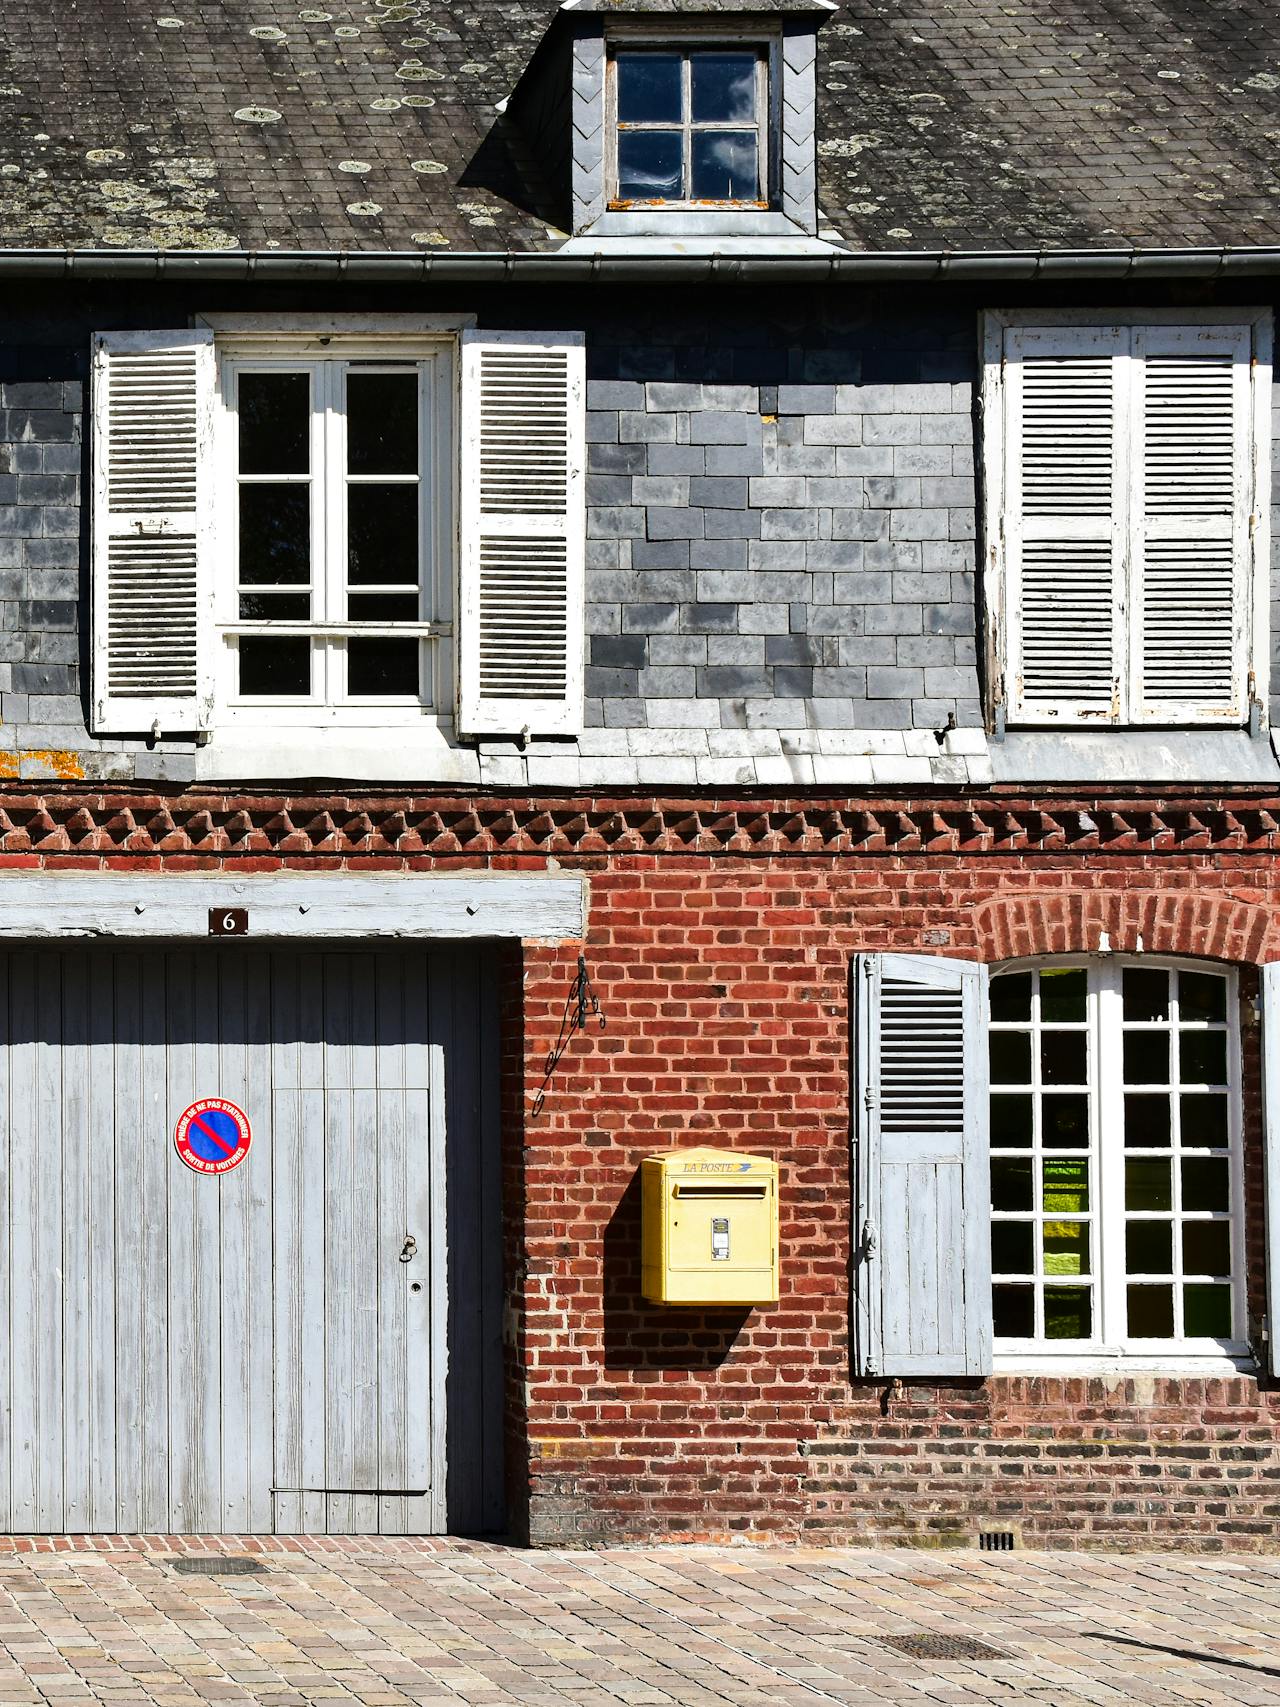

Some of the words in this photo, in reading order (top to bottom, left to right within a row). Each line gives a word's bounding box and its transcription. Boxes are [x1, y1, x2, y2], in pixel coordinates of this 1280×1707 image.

[223, 912, 236, 930] 6
[178, 1116, 190, 1141] PRIÈRE
[187, 1108, 197, 1118] DE
[196, 1102, 207, 1111] NE
[207, 1101, 221, 1109] PAS
[222, 1103, 248, 1138] STATIONNER
[184, 1149, 205, 1168] SORTIE
[205, 1162, 215, 1171] DE
[216, 1147, 245, 1170] VOITURES
[683, 1163, 697, 1173] LA
[700, 1163, 733, 1173] POSTE
